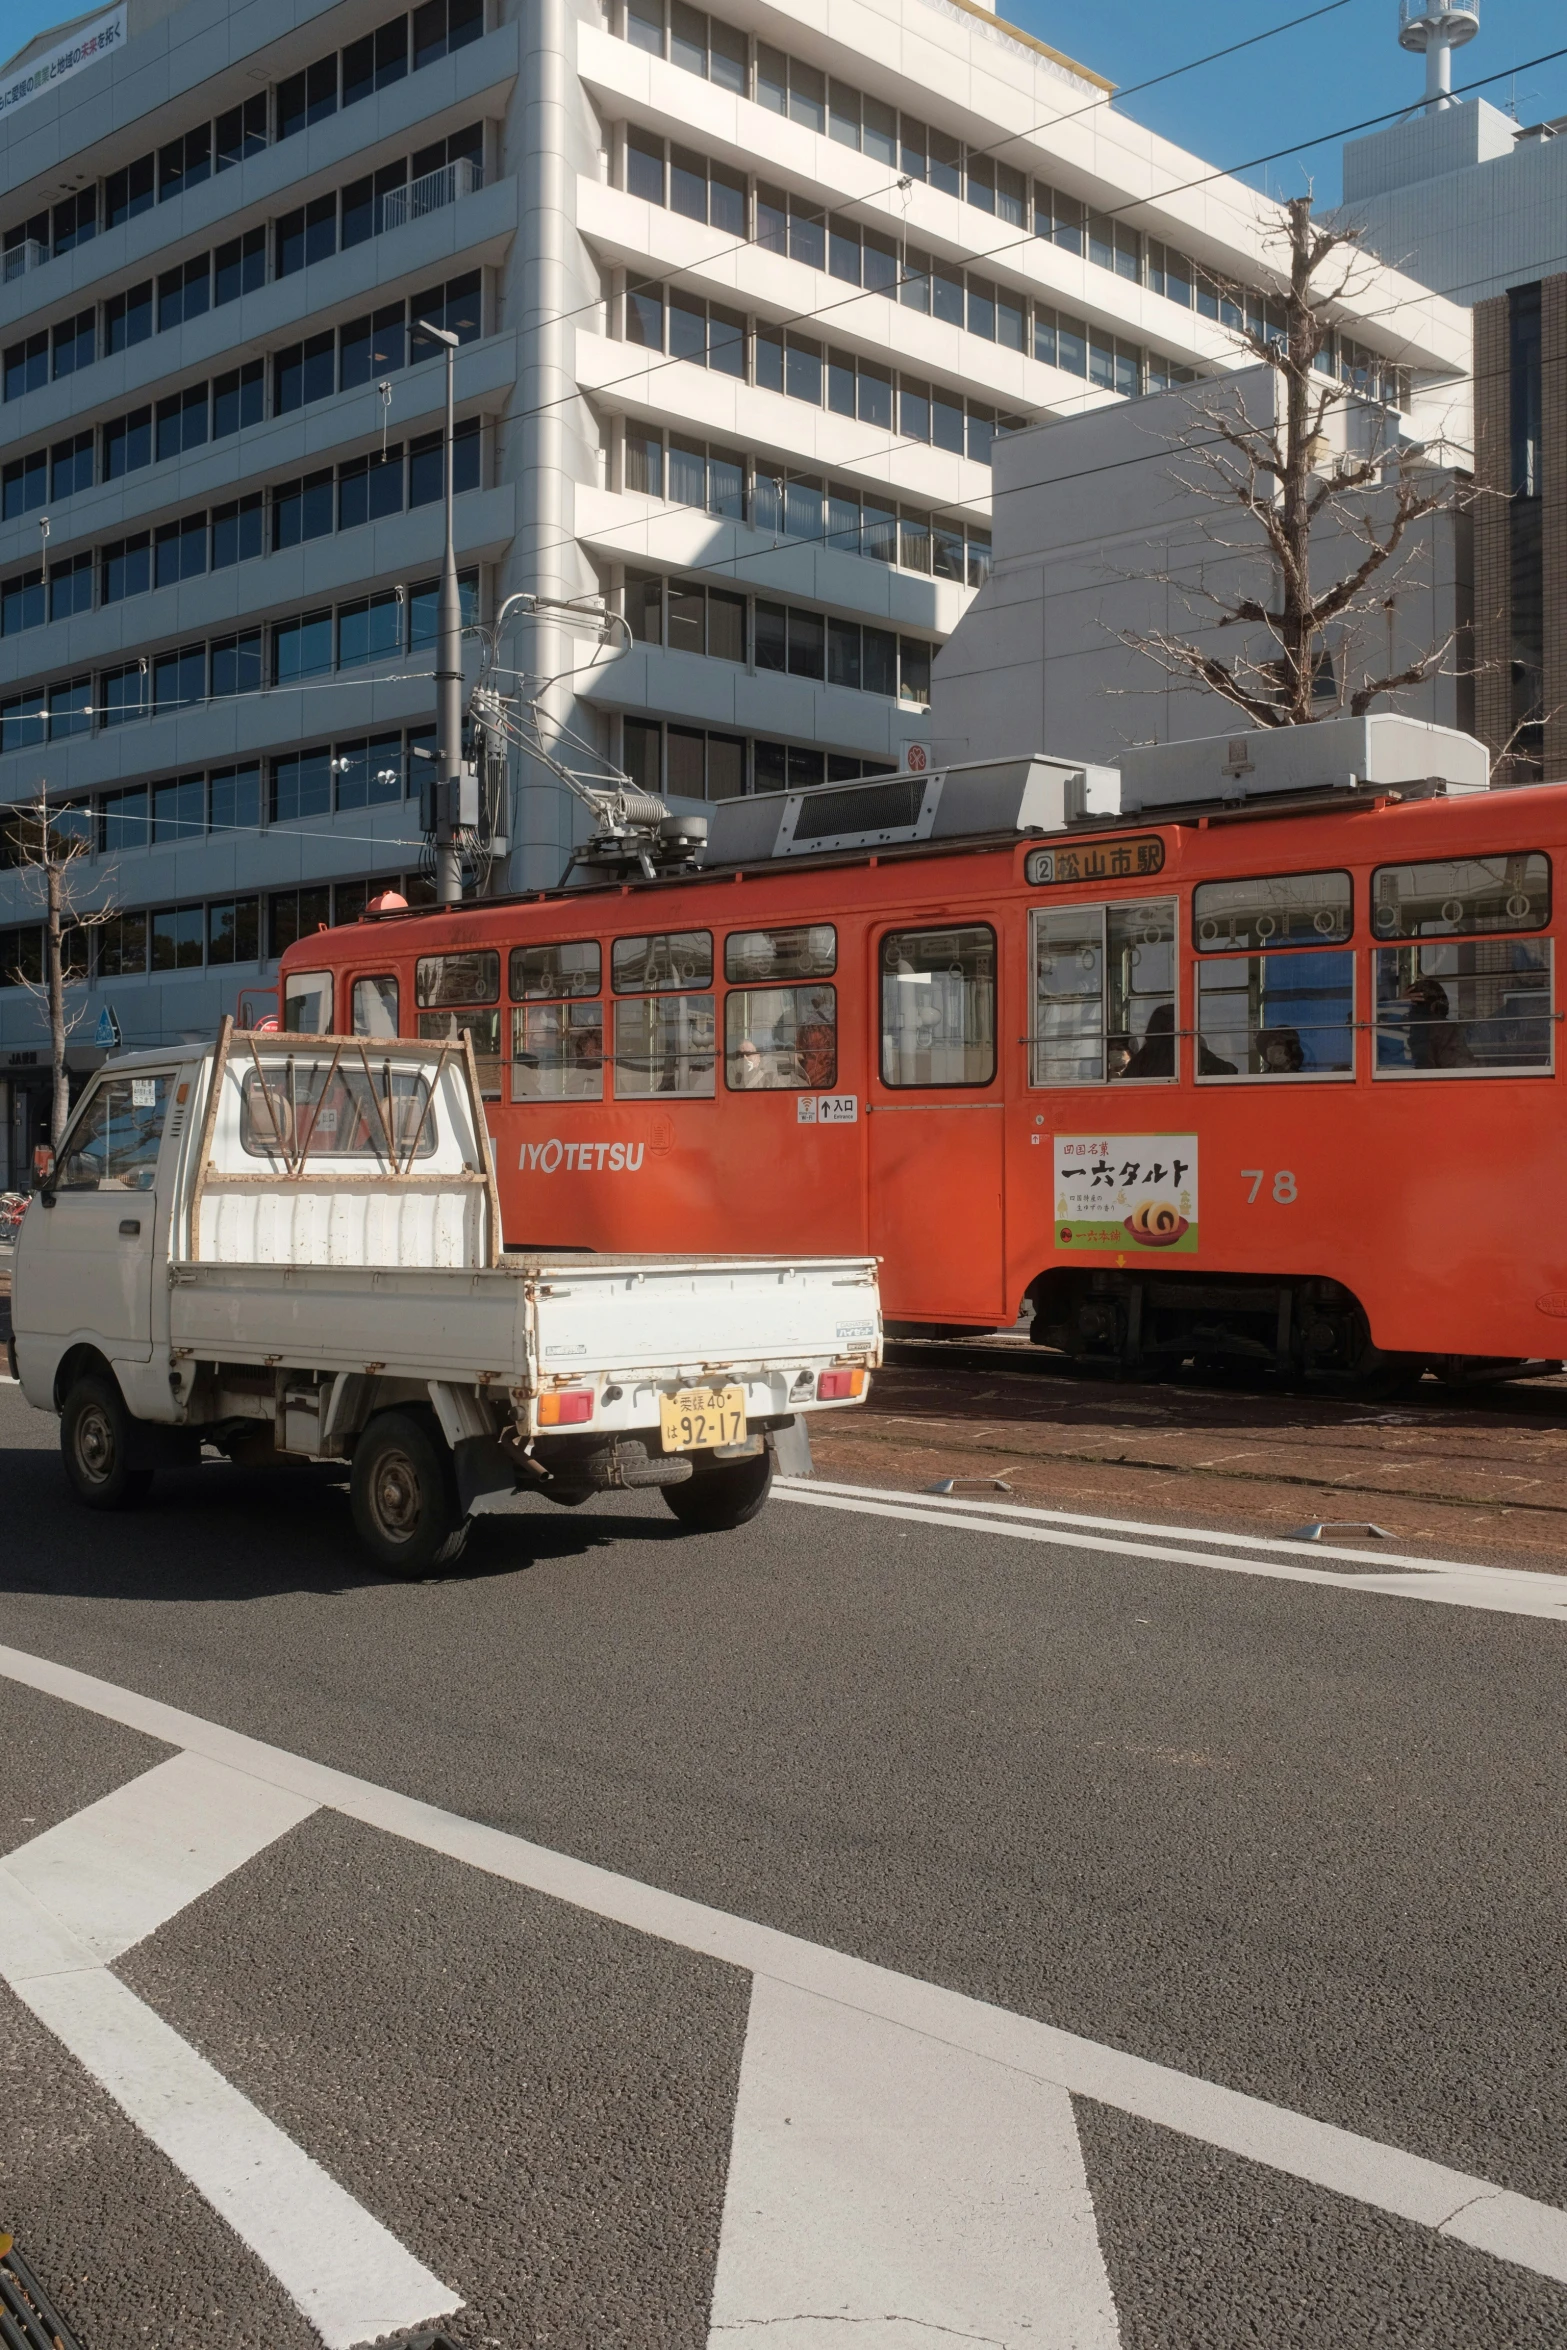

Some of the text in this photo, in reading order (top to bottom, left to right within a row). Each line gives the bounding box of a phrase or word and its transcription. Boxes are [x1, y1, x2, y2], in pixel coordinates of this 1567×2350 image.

[1058, 844, 1160, 880] 松山市駅
[834, 1100, 853, 1111] 入口
[518, 1139, 645, 1173] IYOTETSU
[1063, 1141, 1110, 1156] 四国名菓
[1061, 1159, 1189, 1188] 一六タルト
[1241, 1170, 1298, 1204] 78
